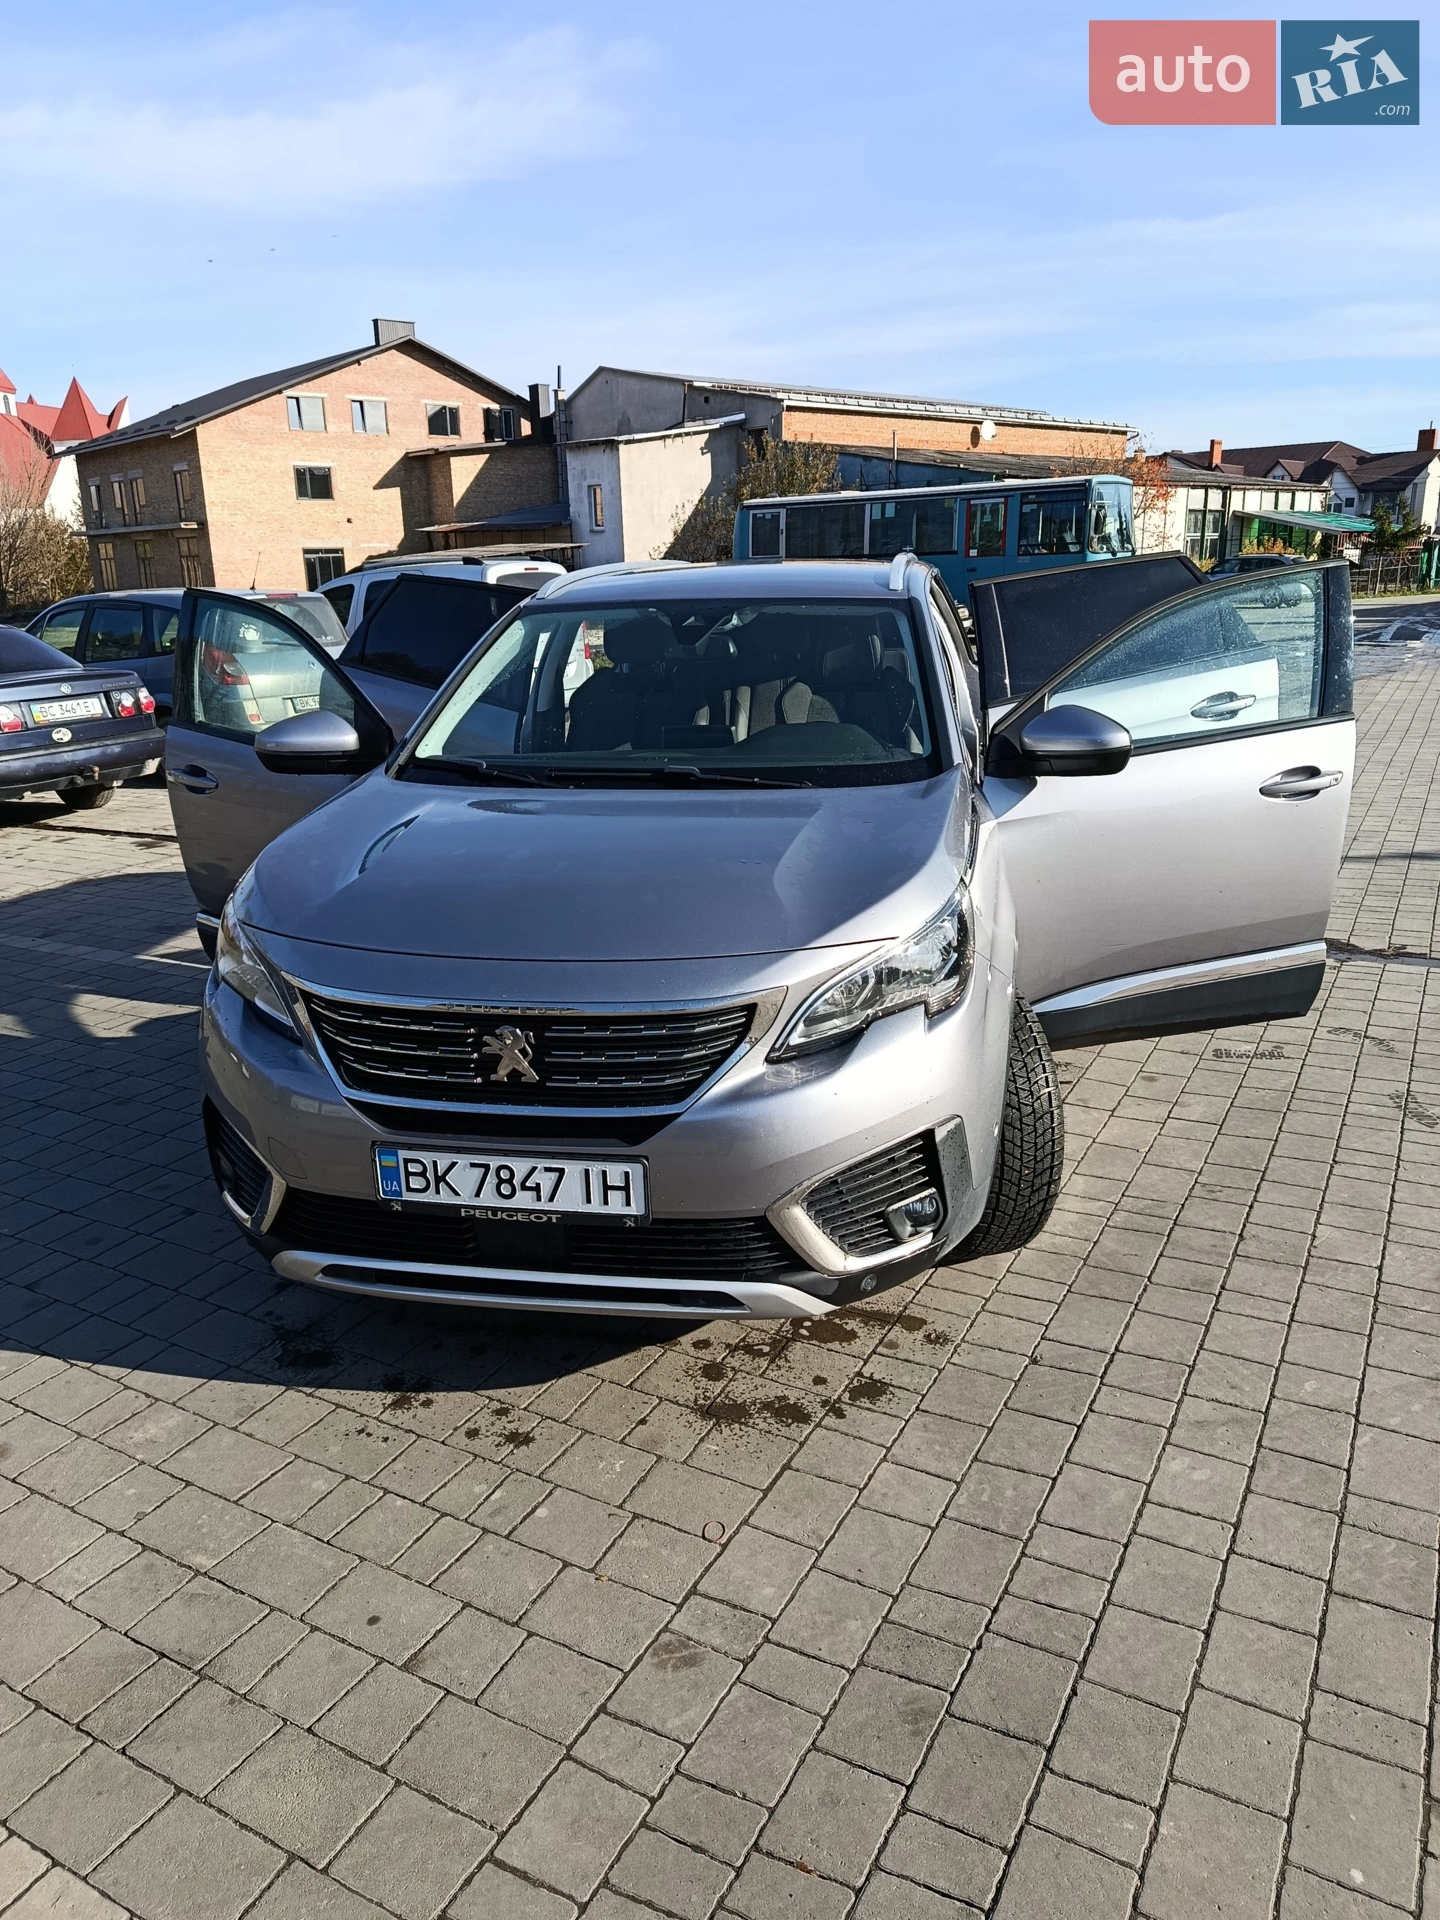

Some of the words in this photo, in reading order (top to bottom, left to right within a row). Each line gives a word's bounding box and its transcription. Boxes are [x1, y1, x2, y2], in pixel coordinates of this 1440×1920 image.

[40, 705, 56, 718] BC
[59, 701, 83, 716] 3461
[446, 1003, 569, 1016] PEUGEOT
[383, 1180, 400, 1191] UA
[402, 1157, 461, 1197] BK
[468, 1162, 566, 1203] 7847
[583, 1167, 633, 1207] IH
[460, 1208, 561, 1224] PEUGEOT
